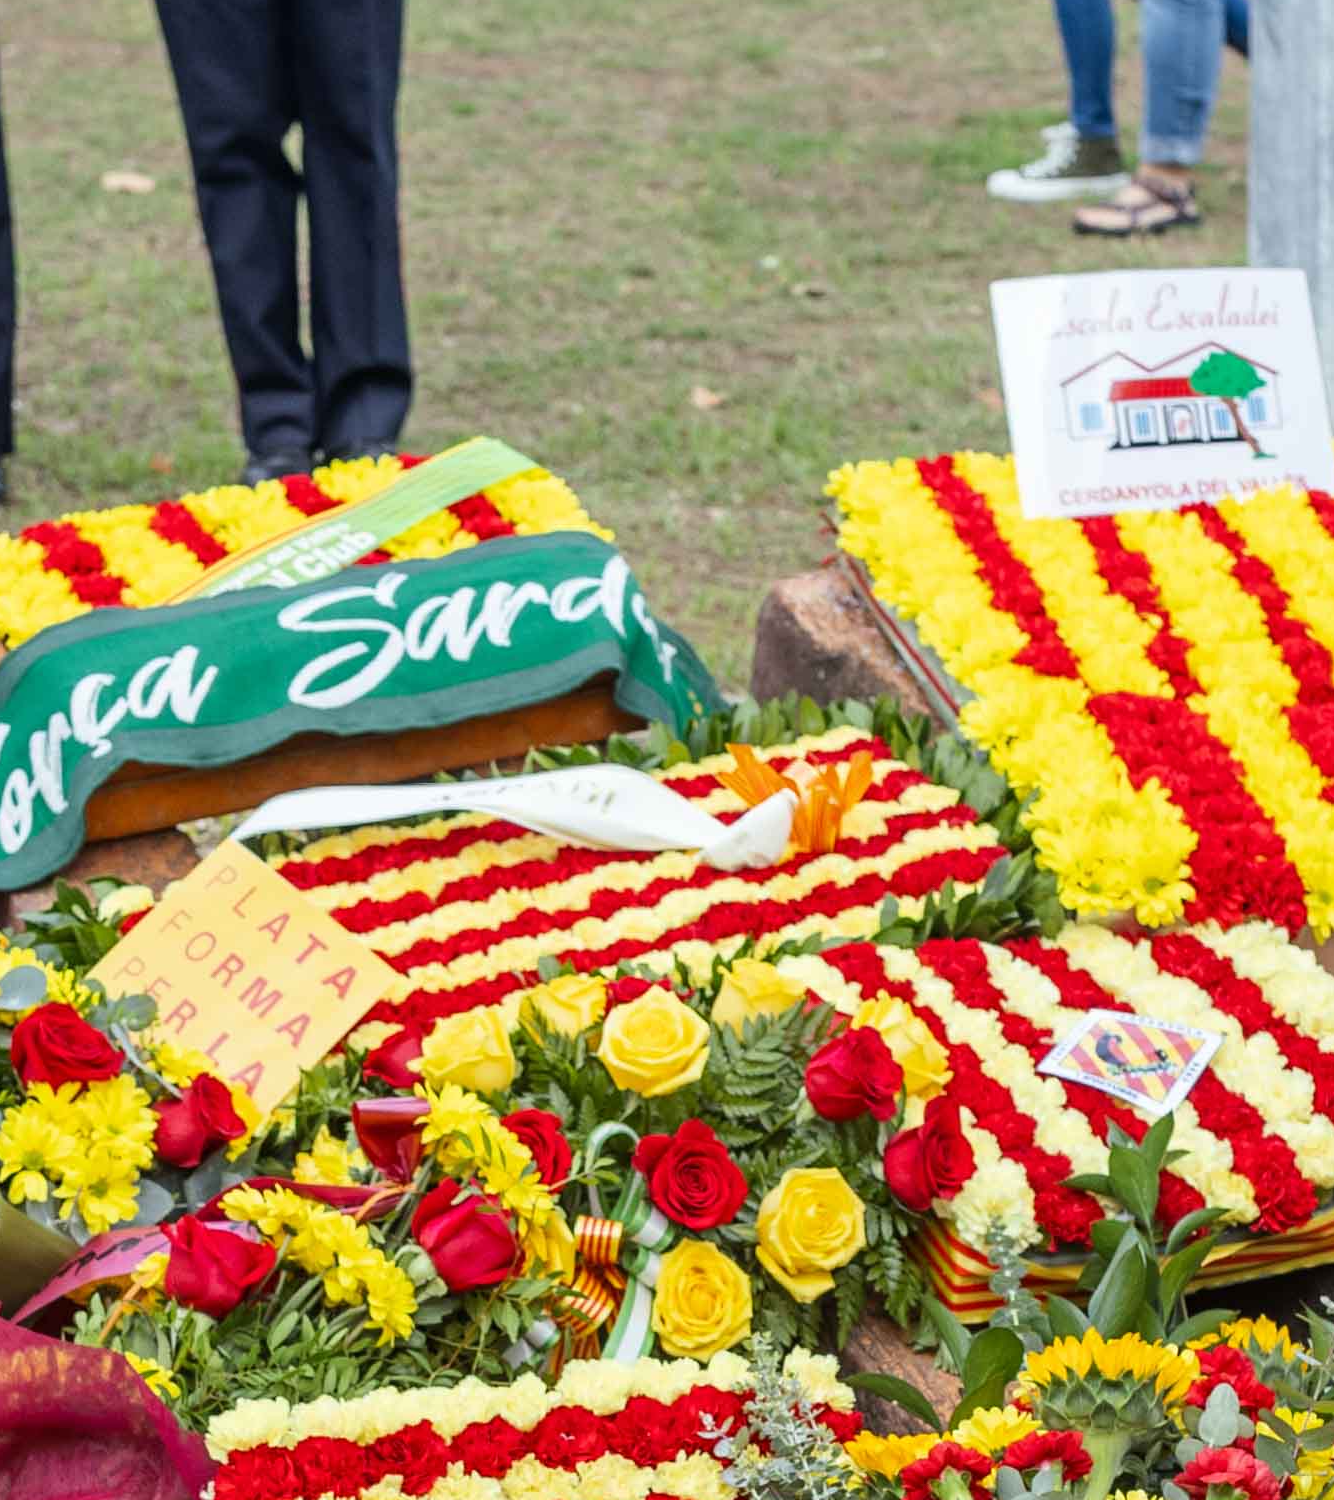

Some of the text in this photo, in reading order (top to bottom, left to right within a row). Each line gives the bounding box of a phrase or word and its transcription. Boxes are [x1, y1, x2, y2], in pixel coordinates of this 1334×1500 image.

[1058, 478, 1192, 507] CERDANYOLA
[159, 908, 311, 1049] FORMA
[205, 865, 358, 1001] PLATA
[112, 955, 266, 1096] PER LA
